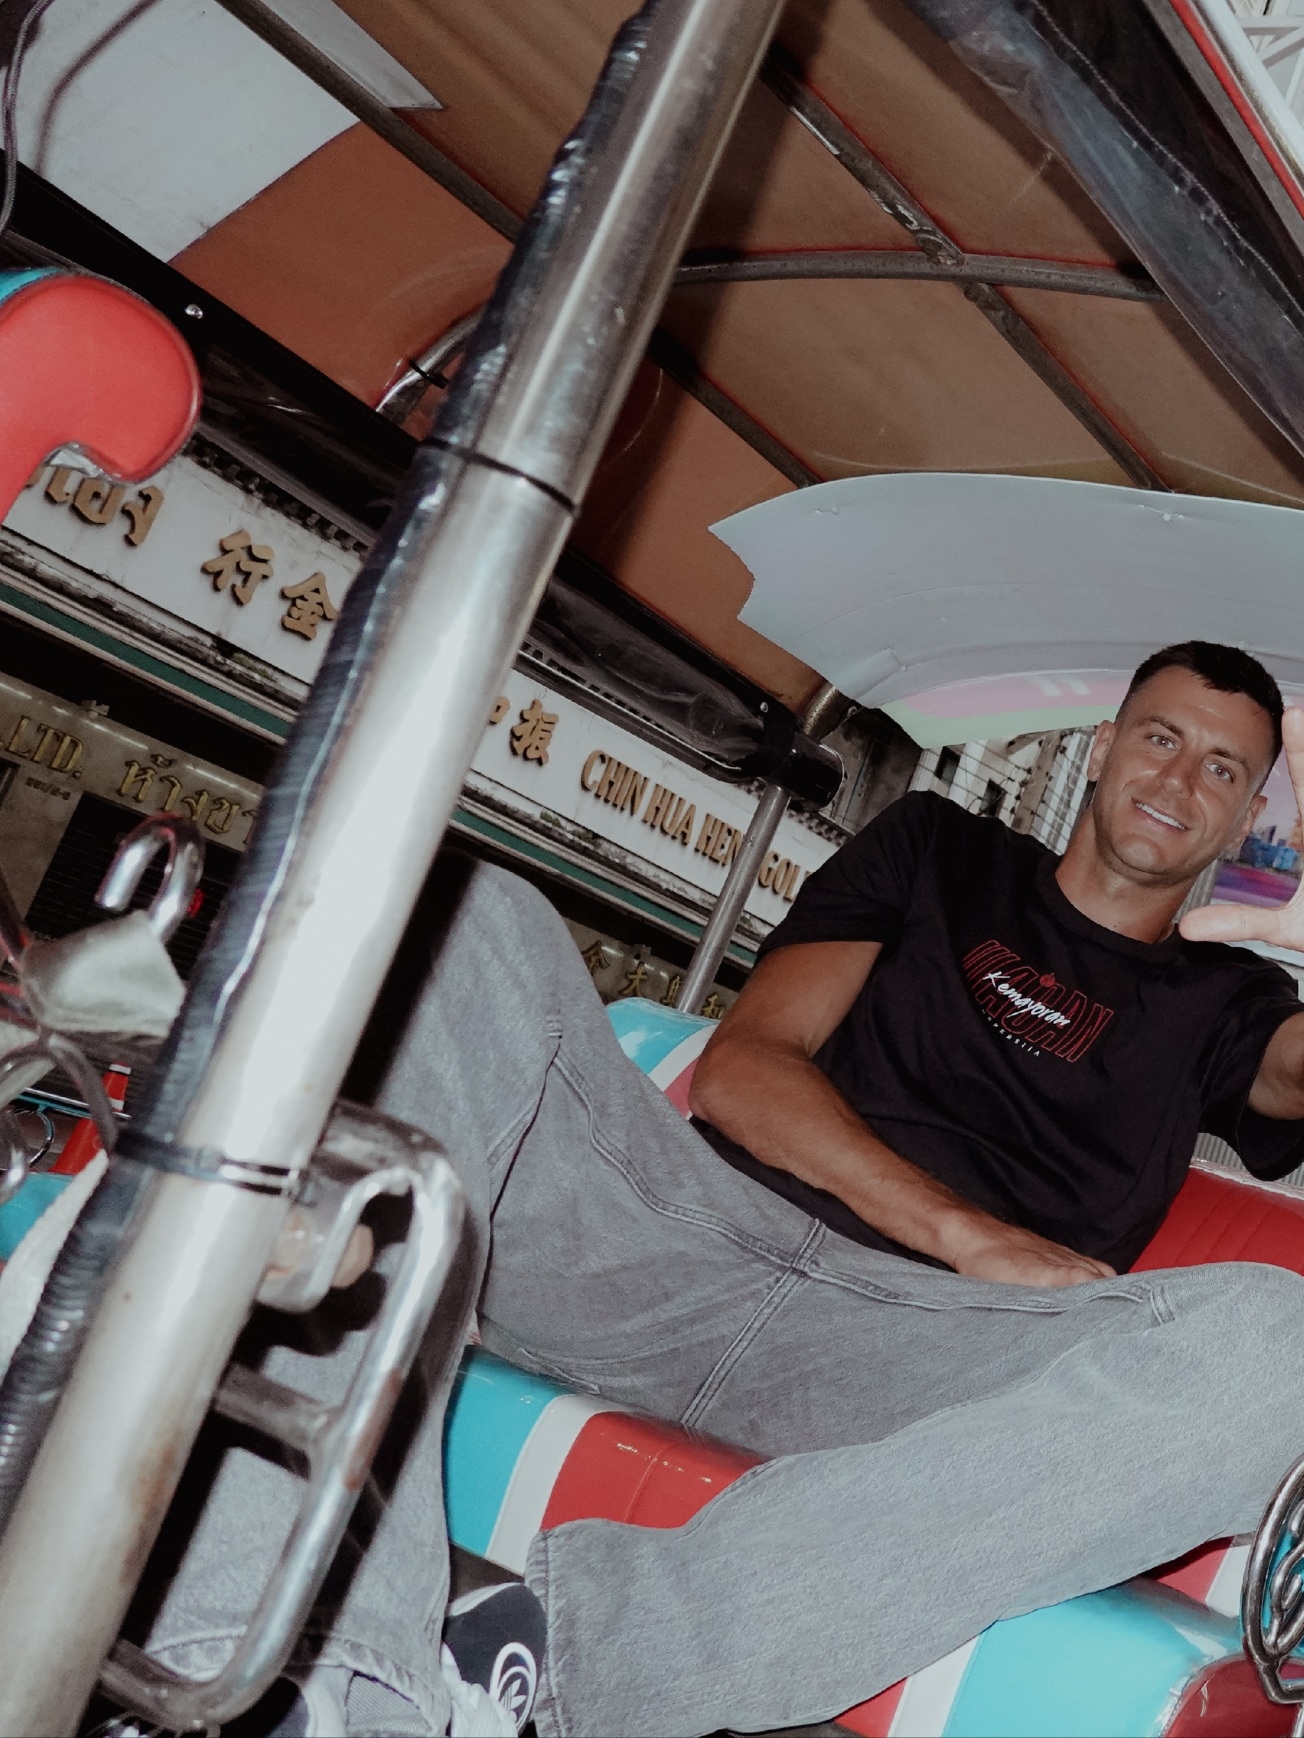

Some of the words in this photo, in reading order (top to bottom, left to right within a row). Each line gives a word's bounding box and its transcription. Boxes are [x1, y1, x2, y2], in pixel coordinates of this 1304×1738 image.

[8, 715, 82, 779] LTD.
[580, 748, 651, 817] CHIN
[641, 783, 697, 846] HUA
[694, 812, 748, 867] HEN
[757, 849, 814, 903] GOL
[982, 970, 1072, 1027] Kemayoran
